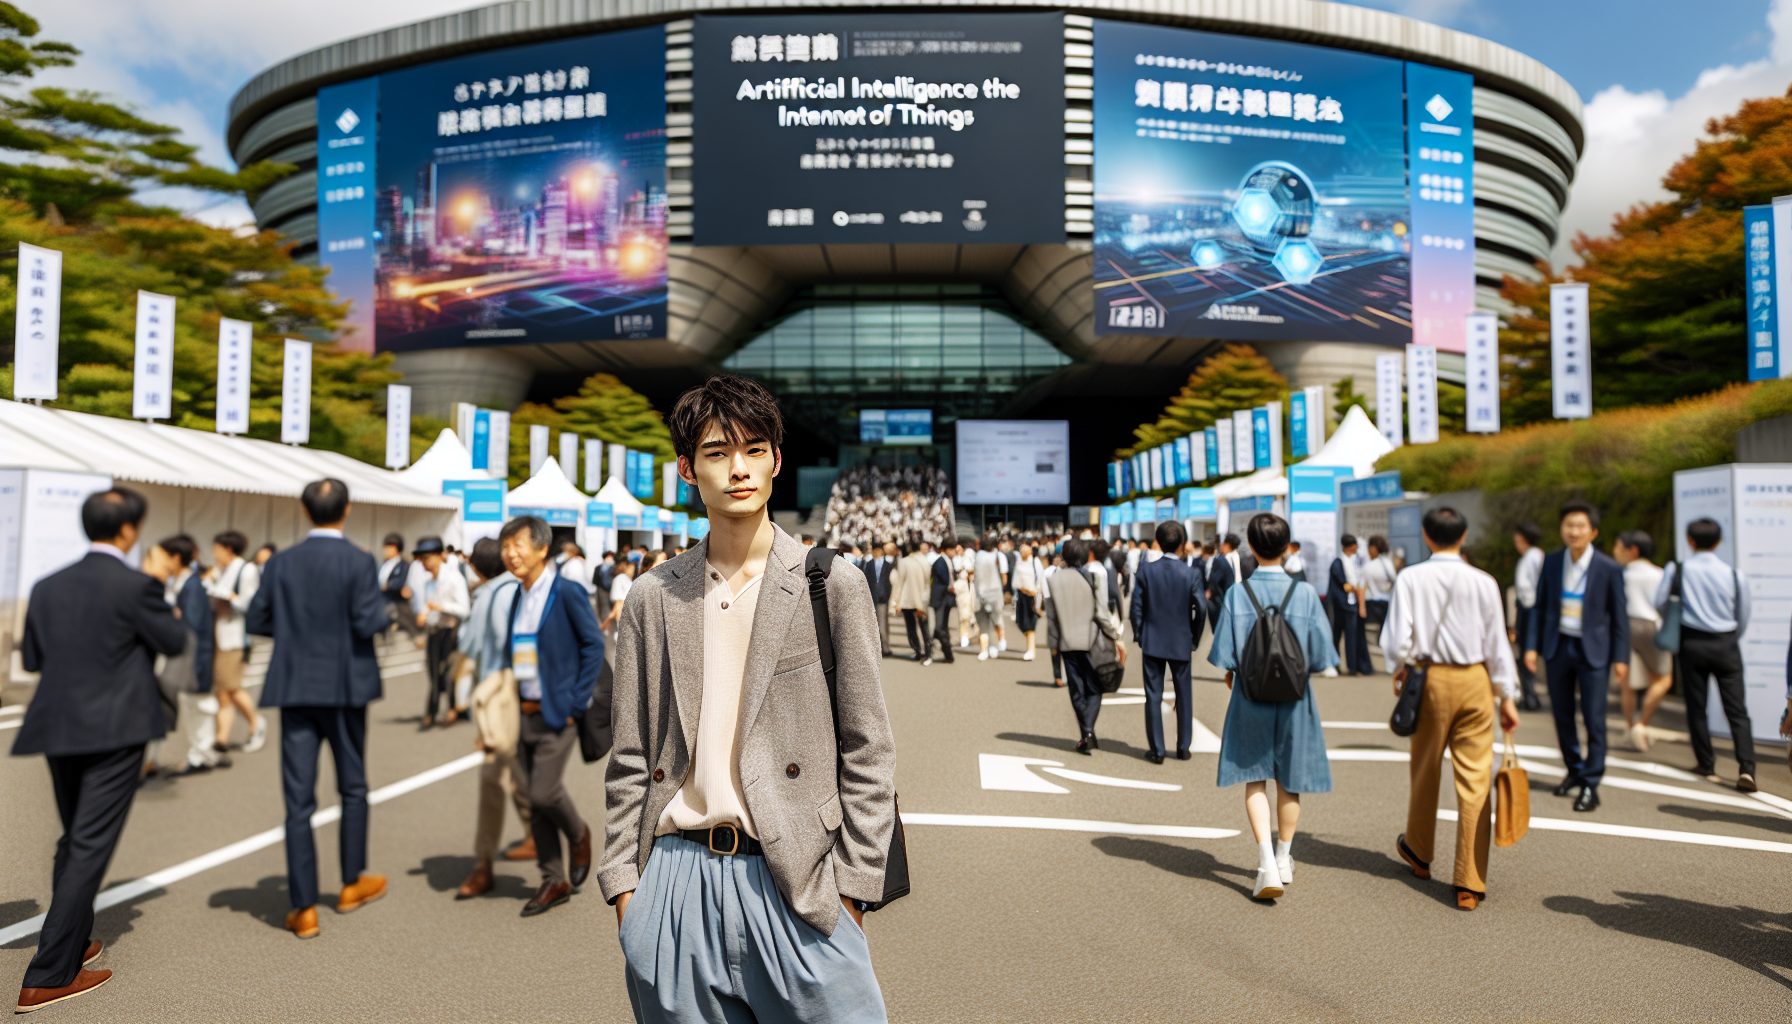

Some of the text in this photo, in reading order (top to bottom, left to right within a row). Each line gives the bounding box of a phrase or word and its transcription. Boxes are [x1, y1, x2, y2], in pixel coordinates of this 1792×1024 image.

[982, 77, 1021, 100] the
[869, 104, 894, 126] of
[896, 103, 975, 131] Things
